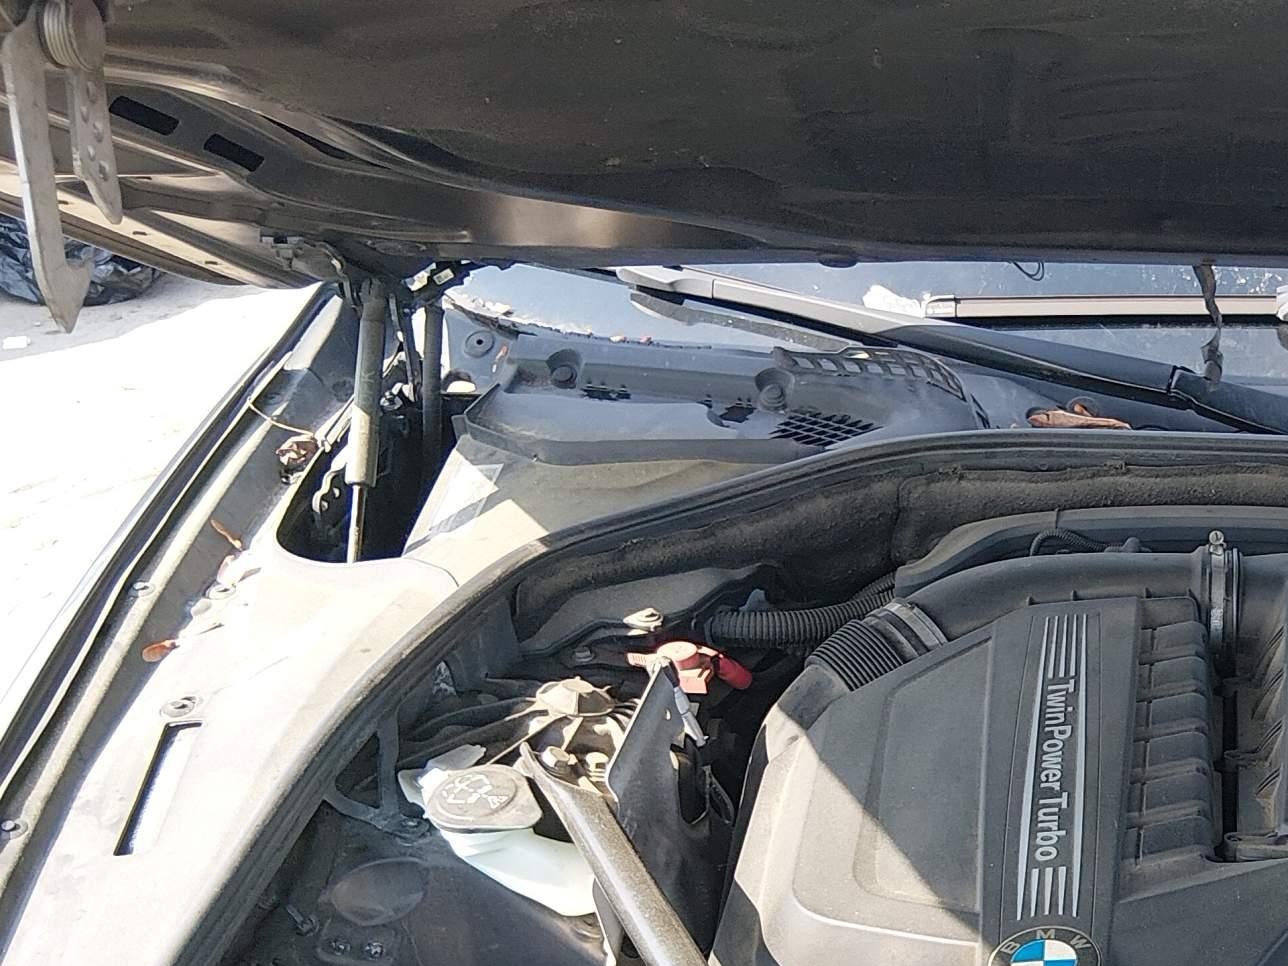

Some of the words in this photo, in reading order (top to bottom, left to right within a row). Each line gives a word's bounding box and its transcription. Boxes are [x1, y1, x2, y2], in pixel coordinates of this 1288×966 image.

[1039, 678, 1076, 791] TwinPower
[1034, 791, 1070, 862] Turbo
[1000, 928, 1092, 955] BMW
